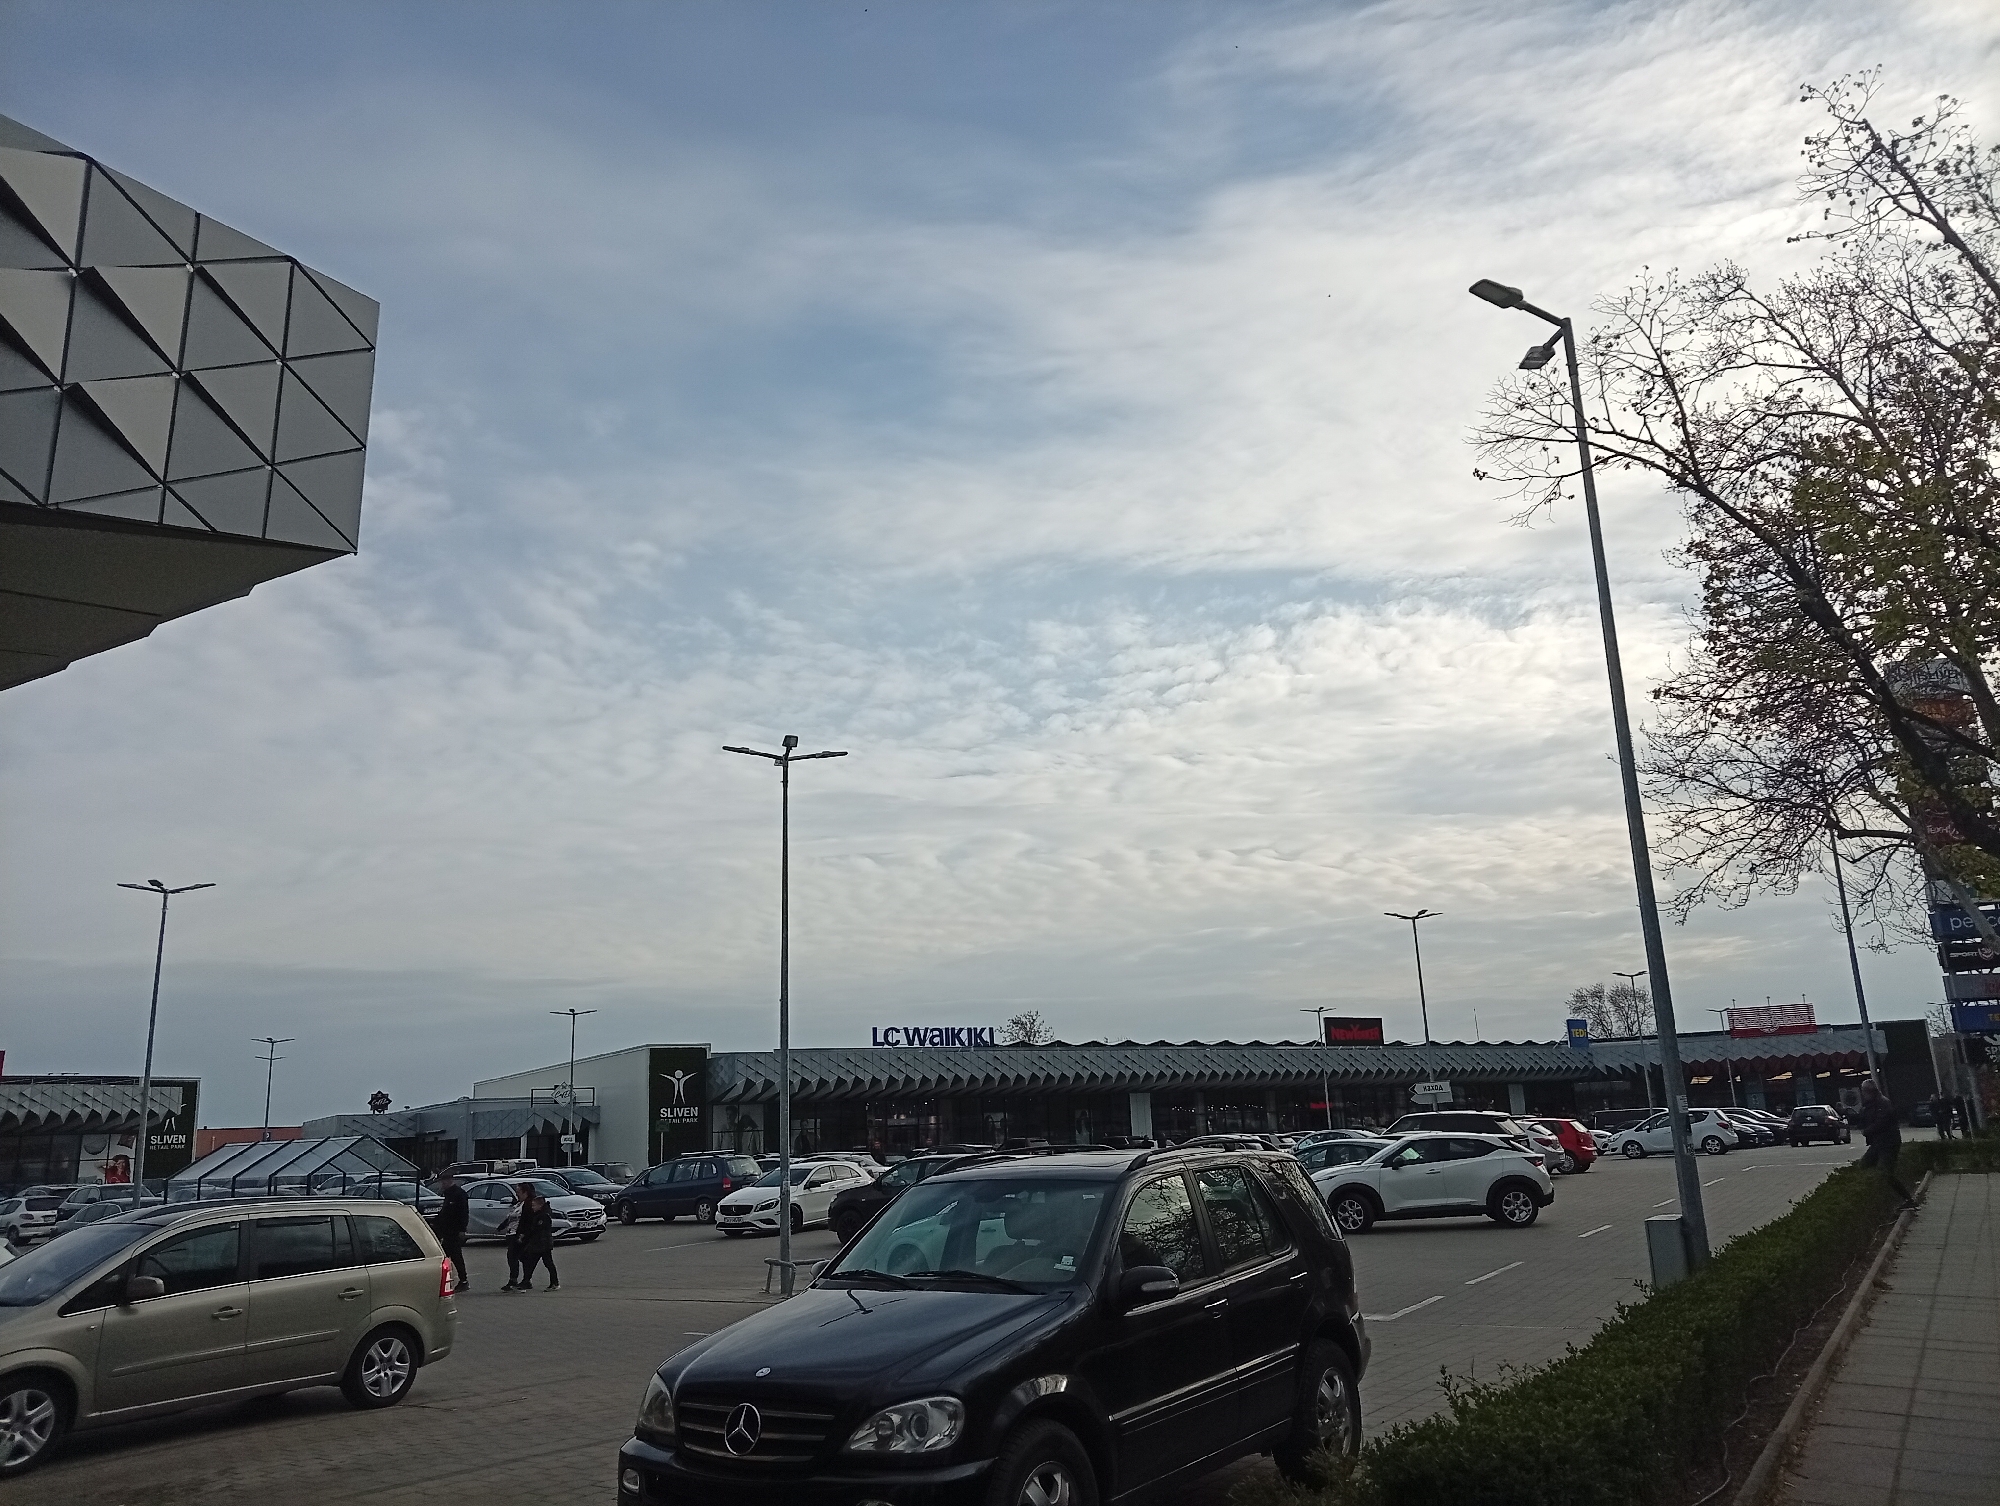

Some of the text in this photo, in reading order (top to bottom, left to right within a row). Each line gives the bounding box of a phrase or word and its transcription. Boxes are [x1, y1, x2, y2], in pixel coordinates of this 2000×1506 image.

[1949, 916, 2000, 930] pec
[872, 1027, 900, 1046] LC
[659, 1106, 699, 1118] SLIVEN
[150, 1134, 187, 1145] SLIVEN
